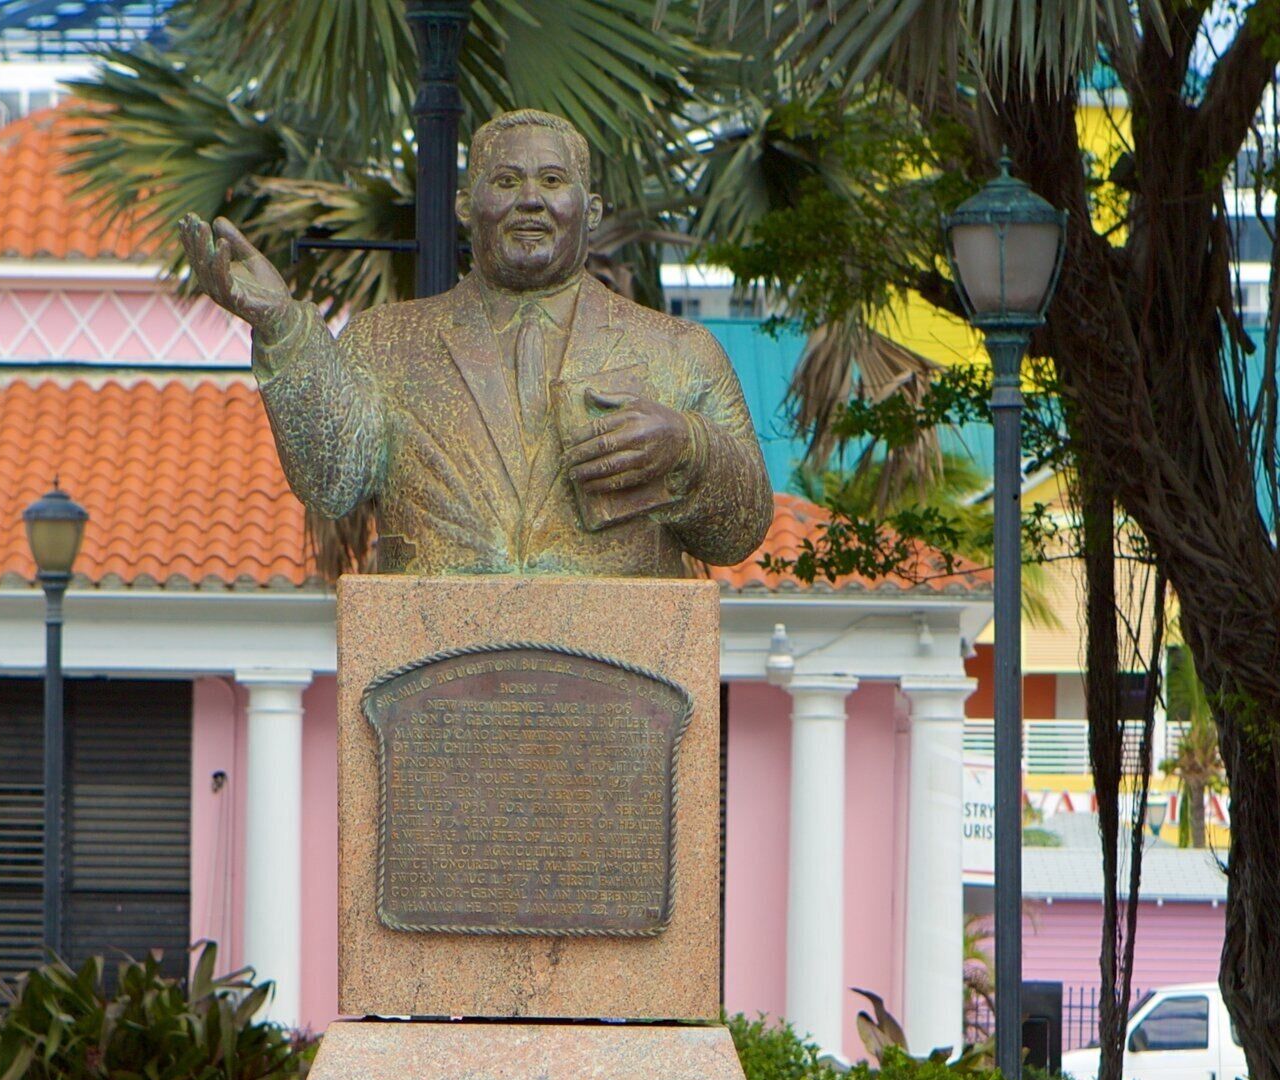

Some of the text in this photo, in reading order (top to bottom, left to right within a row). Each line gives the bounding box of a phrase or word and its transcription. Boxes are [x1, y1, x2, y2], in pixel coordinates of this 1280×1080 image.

[500, 682, 558, 694] BORN AT
[427, 699, 457, 711] NEW
[410, 713, 438, 724] SON
[443, 713, 461, 724] OF
[466, 714, 520, 726] GEORGE
[537, 716, 593, 727] FRANCIS
[522, 729, 574, 742] WATSON
[589, 731, 617, 743] WAS
[619, 732, 666, 743] FATHER
[392, 741, 410, 753] OF
[413, 742, 438, 753] TEN
[518, 744, 562, 755] SERVED
[567, 745, 582, 756] AS
[392, 771, 447, 783] ELECTED
[451, 772, 470, 783] TO
[522, 773, 538, 784] OF
[542, 774, 605, 787] ASSEMBLY
[640, 777, 665, 786] FOR
[391, 785, 416, 798] THE
[420, 786, 481, 798] WESTERN
[547, 789, 593, 800] SERVED
[598, 789, 633, 801] UNTIL
[392, 800, 454, 812] ELECTED
[498, 801, 524, 813] FOR
[614, 804, 663, 816] SERVED
[391, 814, 663, 831] UNTIL SERVED AS MINISTER OF HEALTH
[464, 830, 521, 842] MINISTER
[524, 831, 541, 843] OF
[545, 832, 593, 844] LABOUR
[391, 843, 454, 855] MINISTER
[461, 844, 477, 855] OF
[485, 845, 574, 857] AGRICULTURE
[389, 857, 664, 874] TWICE HONOURED HER MAJESTY QUEEN
[390, 872, 436, 883] SWORN
[537, 875, 552, 886] AS
[558, 875, 594, 887] FIRST
[391, 886, 663, 902] GOVERNOR-GENERAL IN AN INDEPENDENT
[465, 902, 481, 913] HE
[488, 902, 518, 915] DIED
[524, 902, 583, 915] JANUARY
